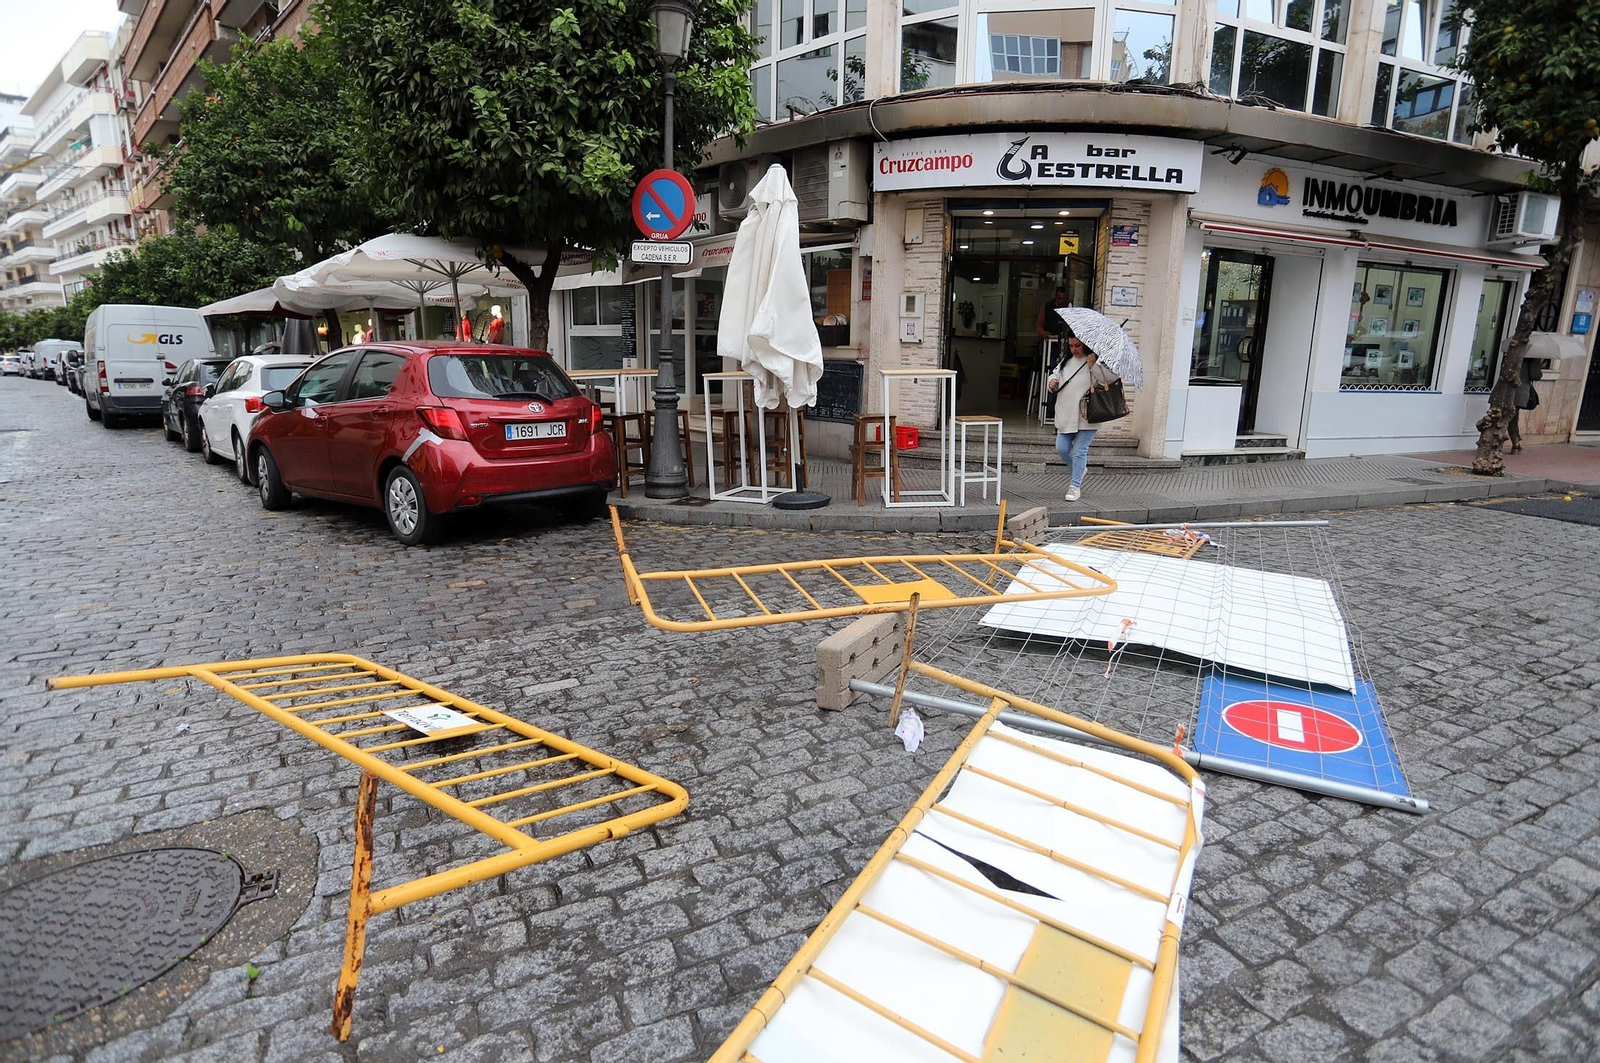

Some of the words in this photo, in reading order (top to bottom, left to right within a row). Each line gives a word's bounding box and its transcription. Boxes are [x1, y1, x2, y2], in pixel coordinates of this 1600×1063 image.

[1086, 144, 1136, 158] bar
[879, 154, 973, 175] Cruzcampo
[1037, 162, 1183, 184] ESTRELLA
[651, 232, 669, 240] GRUA
[633, 244, 658, 252] EXCEPTO
[659, 245, 688, 253] VEHICULOS
[641, 253, 663, 261] CADENA
[158, 334, 183, 345] GLS
[515, 425, 539, 438] 1691
[547, 424, 564, 436] JCR
